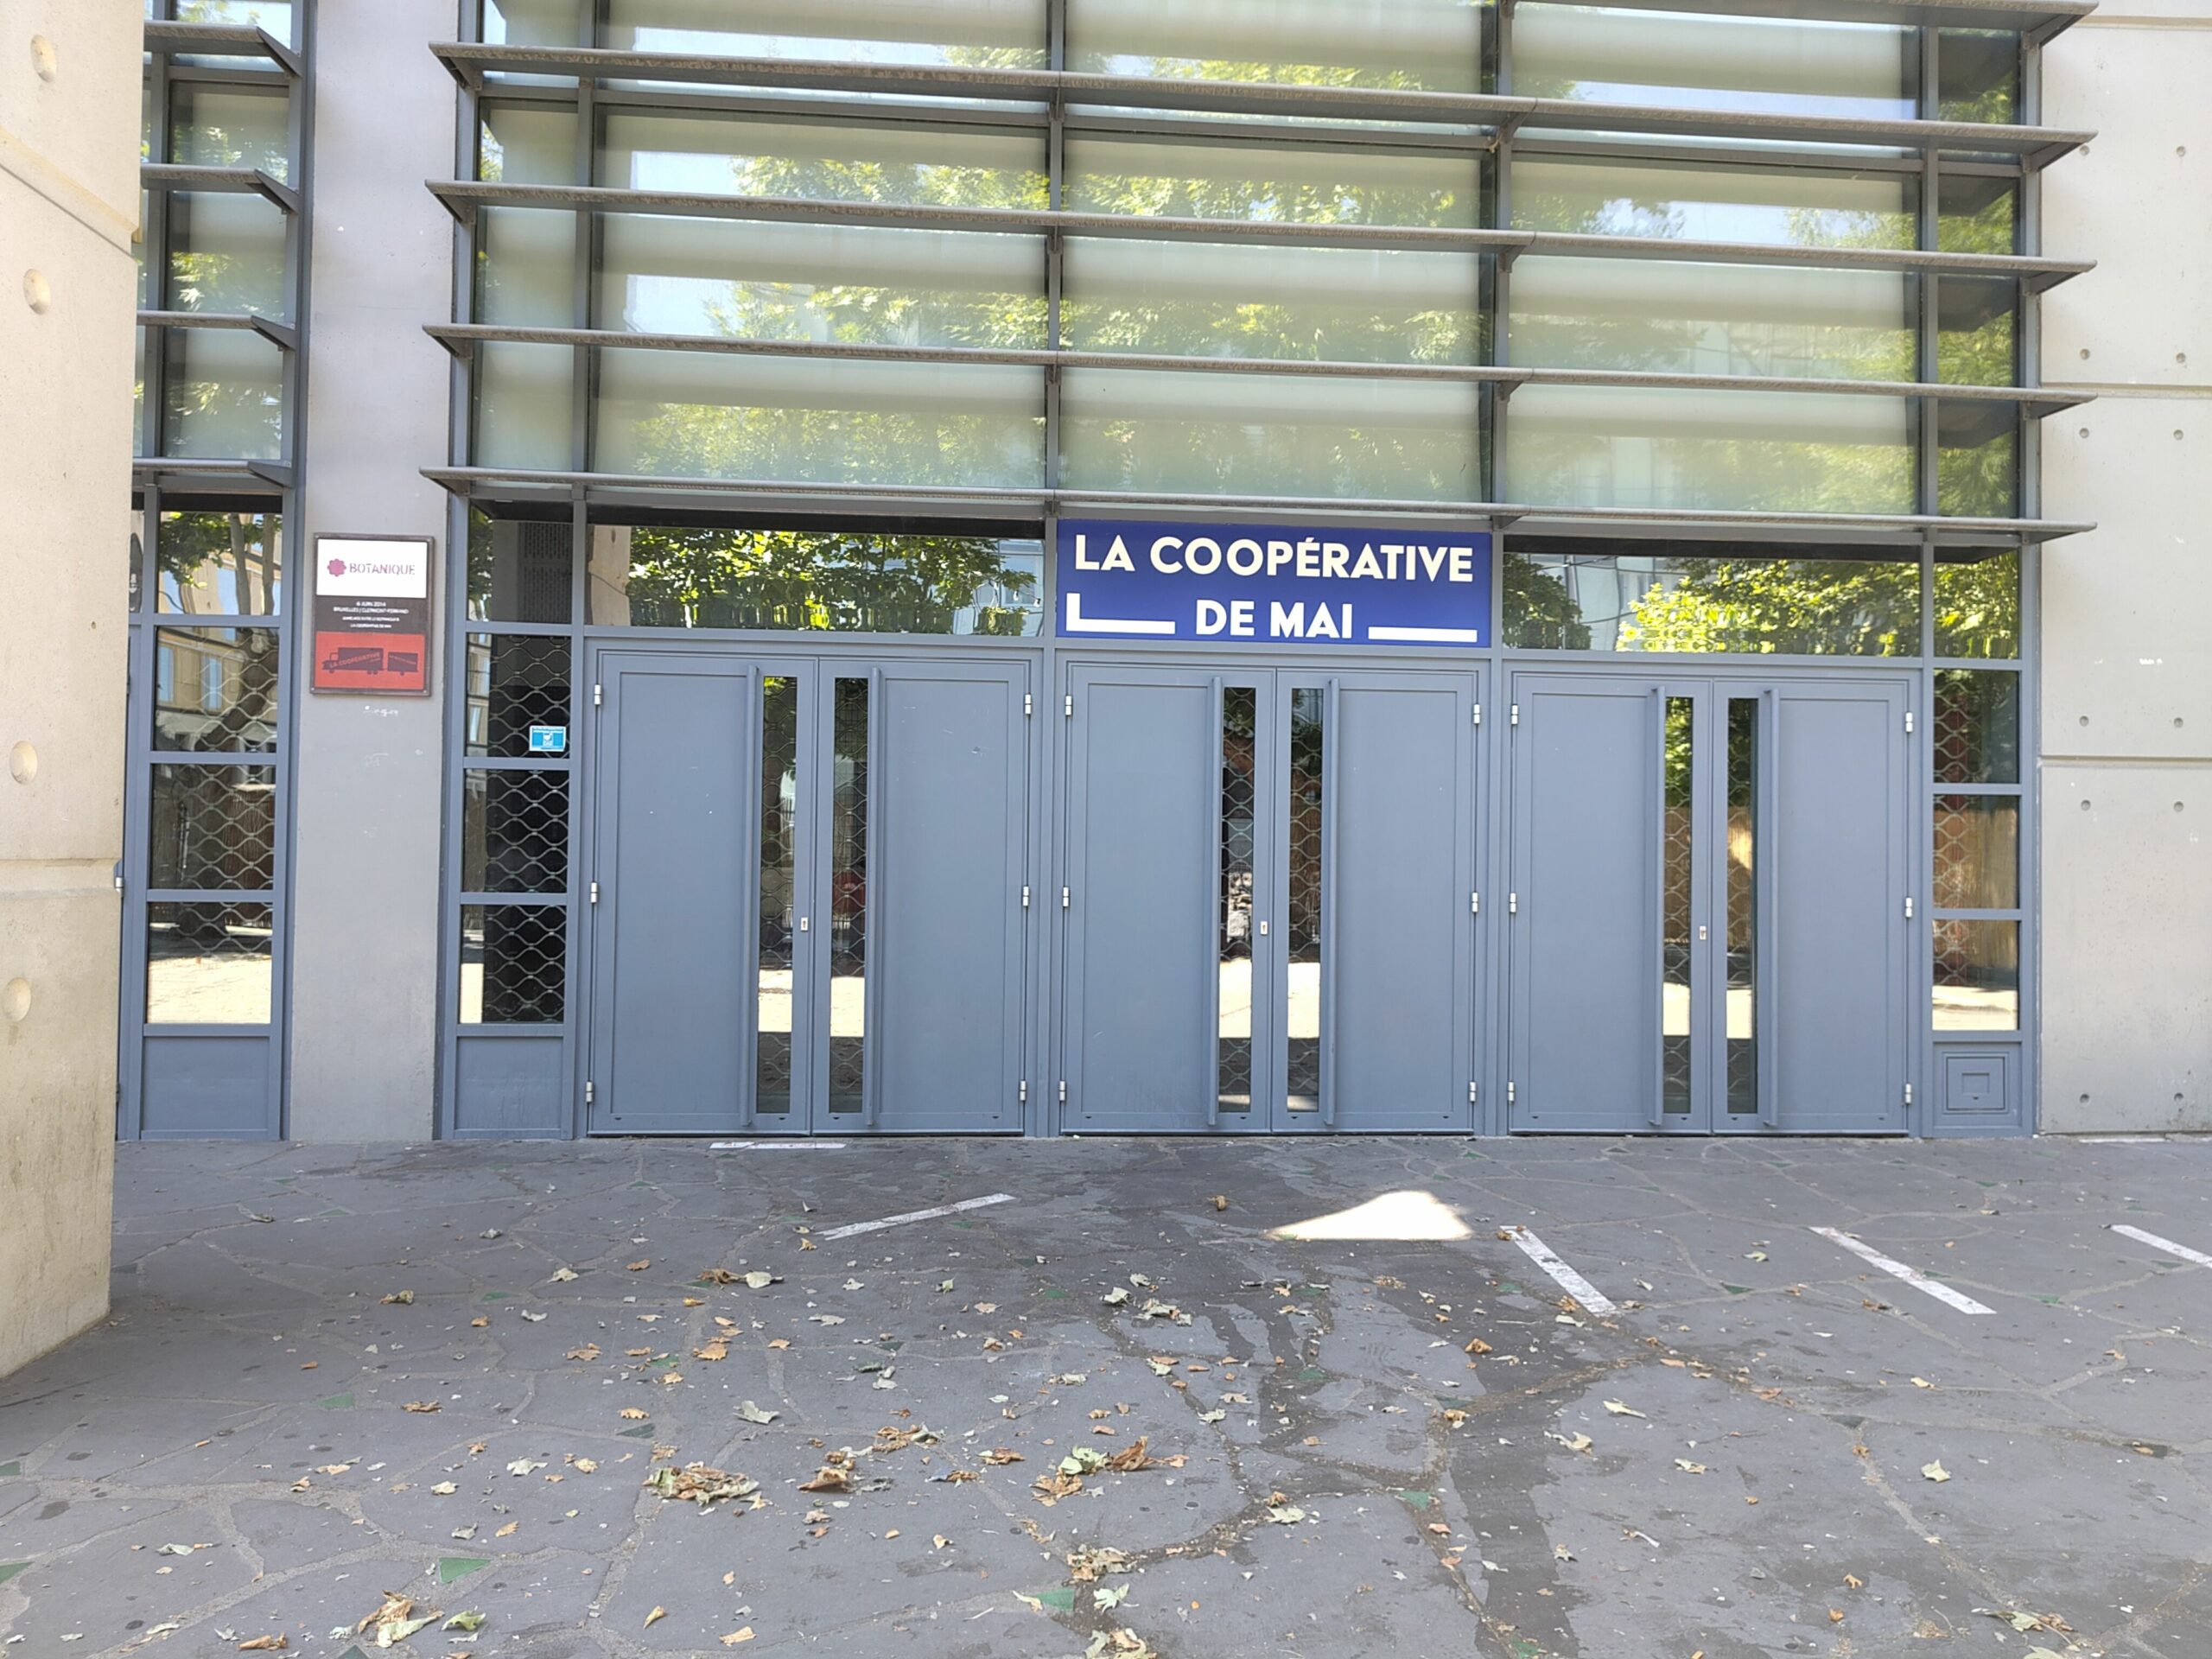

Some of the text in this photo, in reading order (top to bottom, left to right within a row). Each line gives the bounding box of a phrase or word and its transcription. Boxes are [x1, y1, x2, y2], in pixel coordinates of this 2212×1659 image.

[349, 563, 416, 575] BOTANIQUE
[1076, 534, 1474, 582] LA COOPÉRATIVE
[1196, 600, 1353, 639] DE MAI
